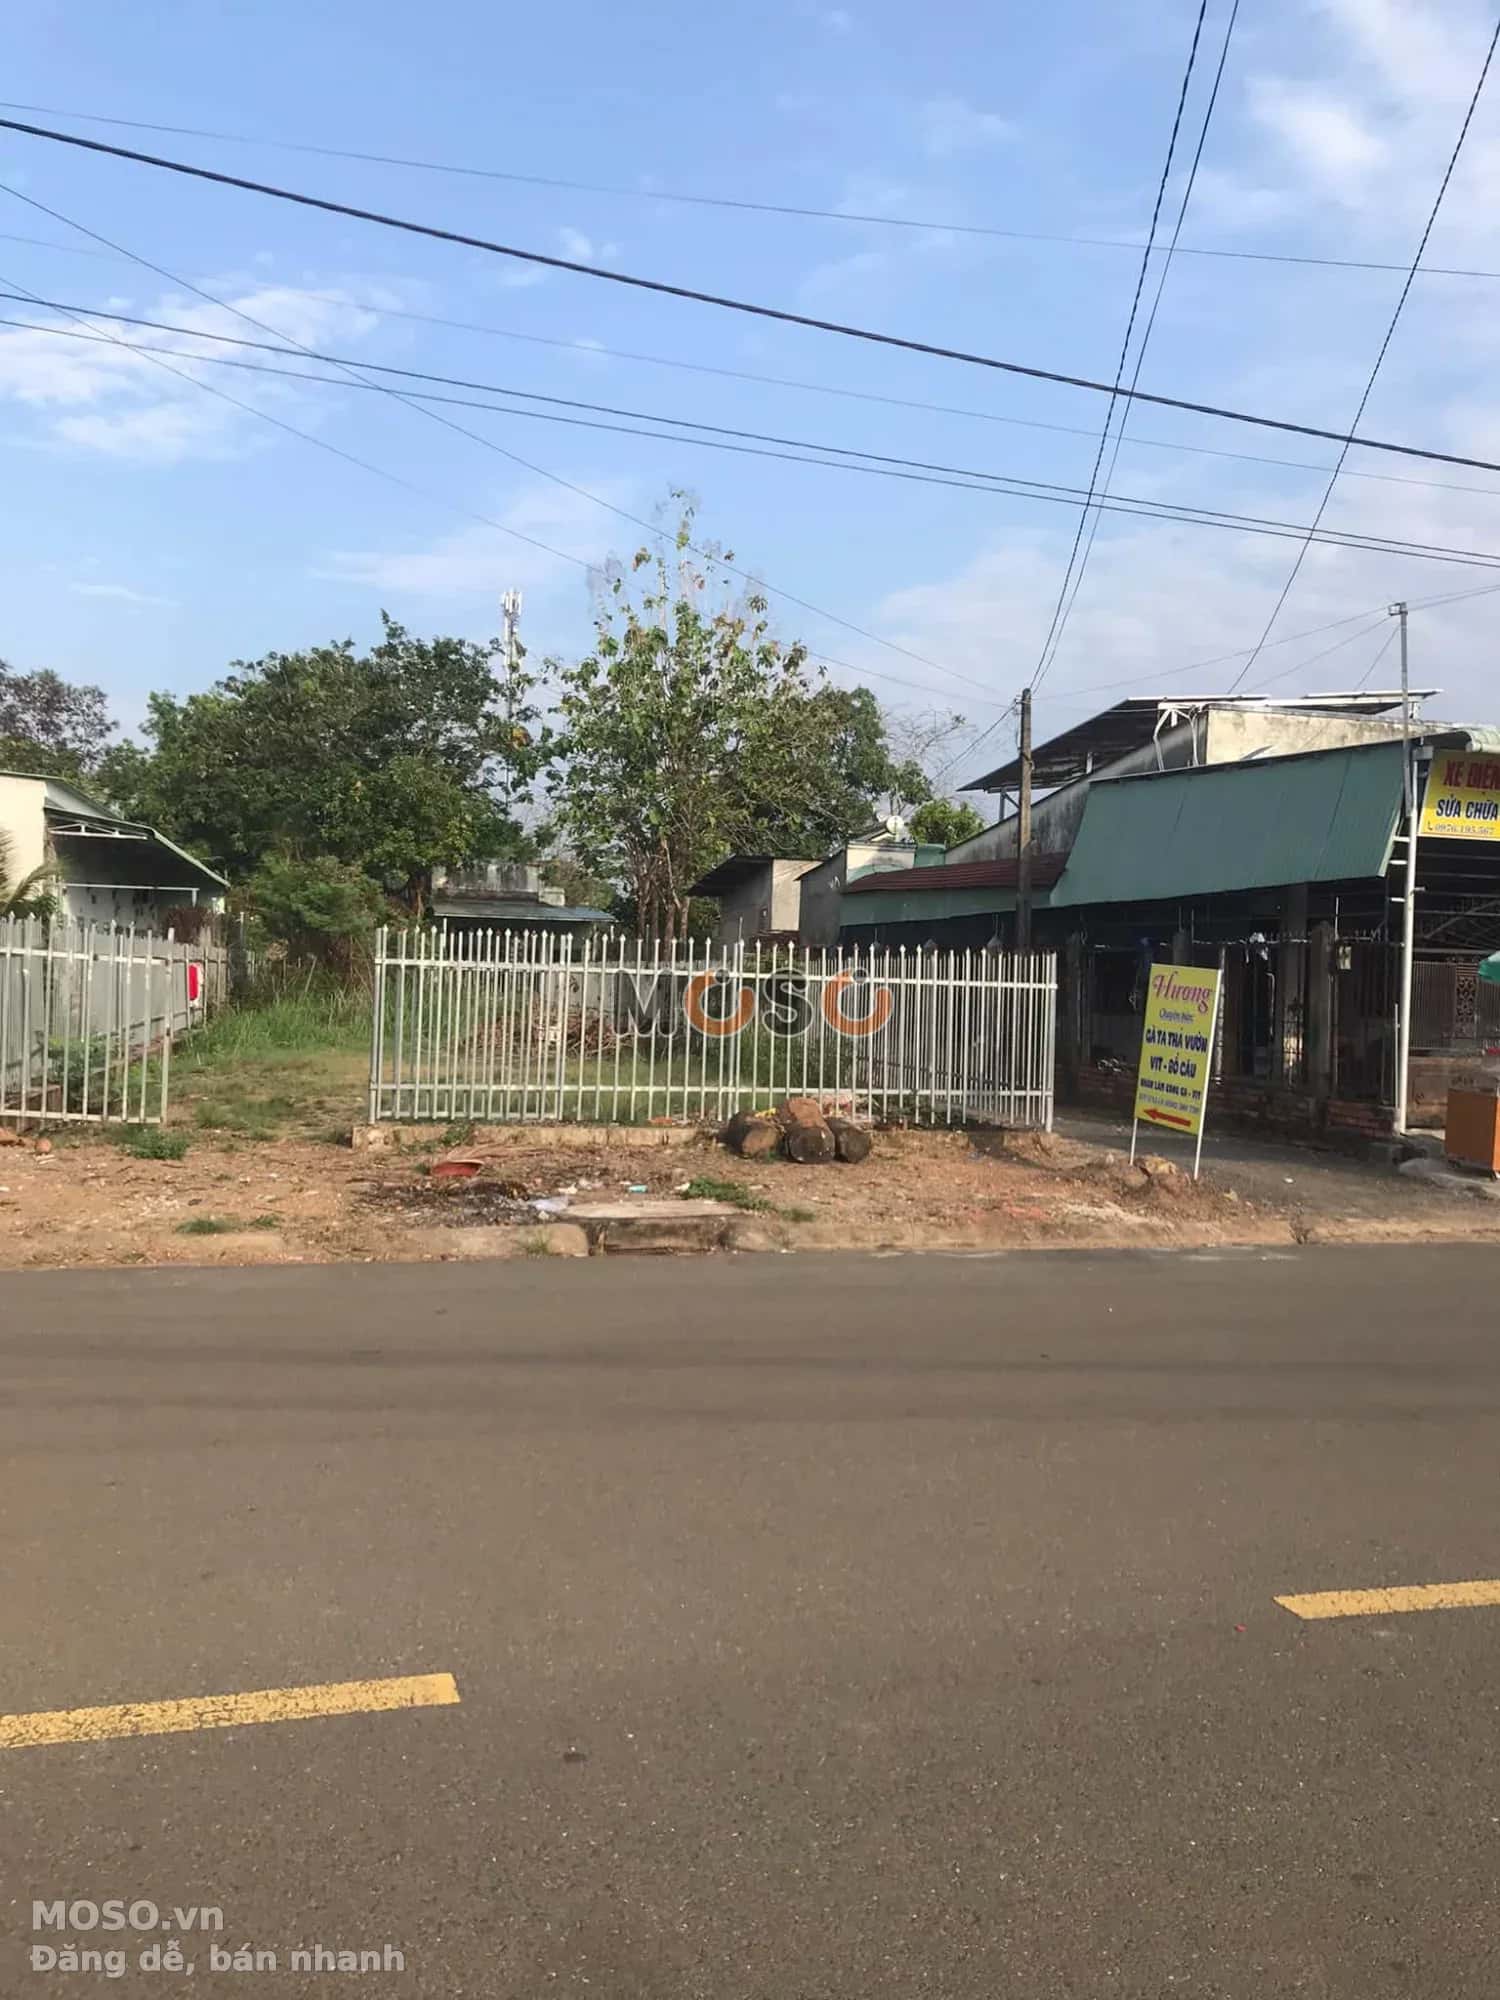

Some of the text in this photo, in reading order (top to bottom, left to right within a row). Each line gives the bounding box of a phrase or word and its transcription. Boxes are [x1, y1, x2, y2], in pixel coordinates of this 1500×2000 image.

[1436, 793, 1498, 821] SỬA CHỮA
[1157, 1029, 1167, 1046] TA
